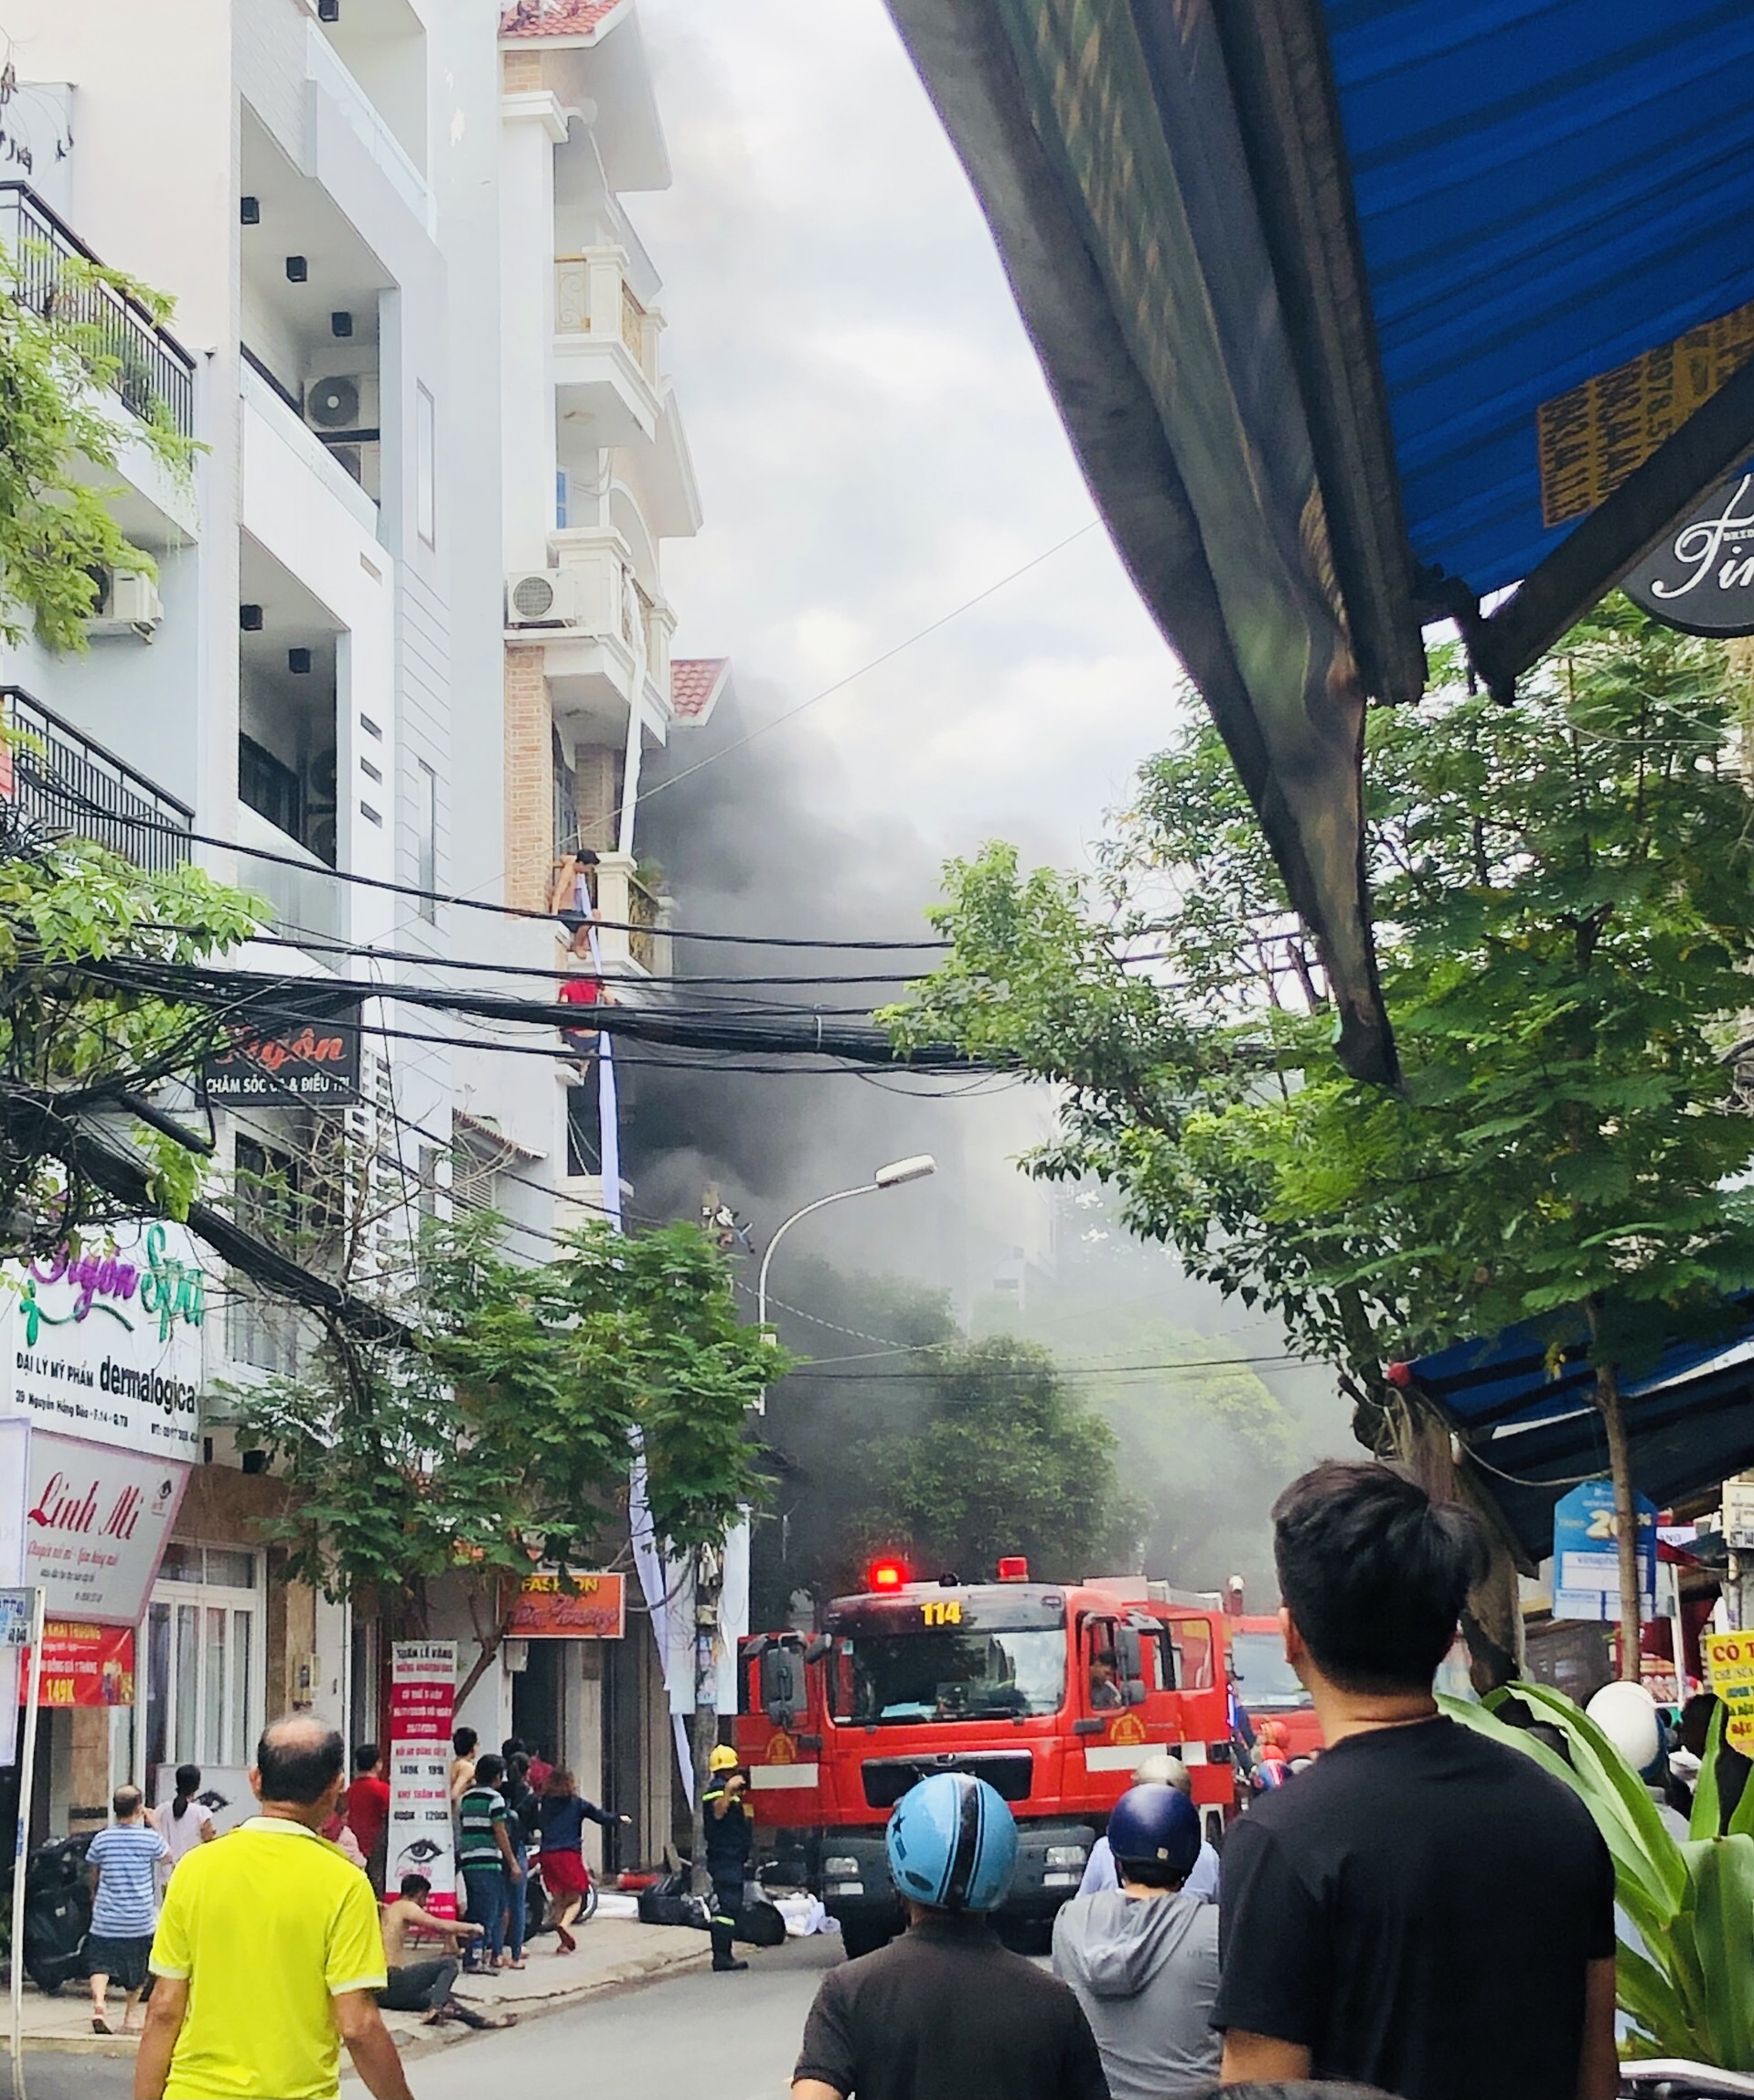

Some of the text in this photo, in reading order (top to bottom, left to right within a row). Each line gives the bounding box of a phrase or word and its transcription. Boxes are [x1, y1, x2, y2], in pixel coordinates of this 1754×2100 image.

[100, 1355, 195, 1415] dermalogica
[28, 1472, 100, 1534] Linh
[521, 1576, 599, 1592] FASON
[920, 1601, 962, 1626] 114
[1713, 1638, 1739, 1662] CÔ
